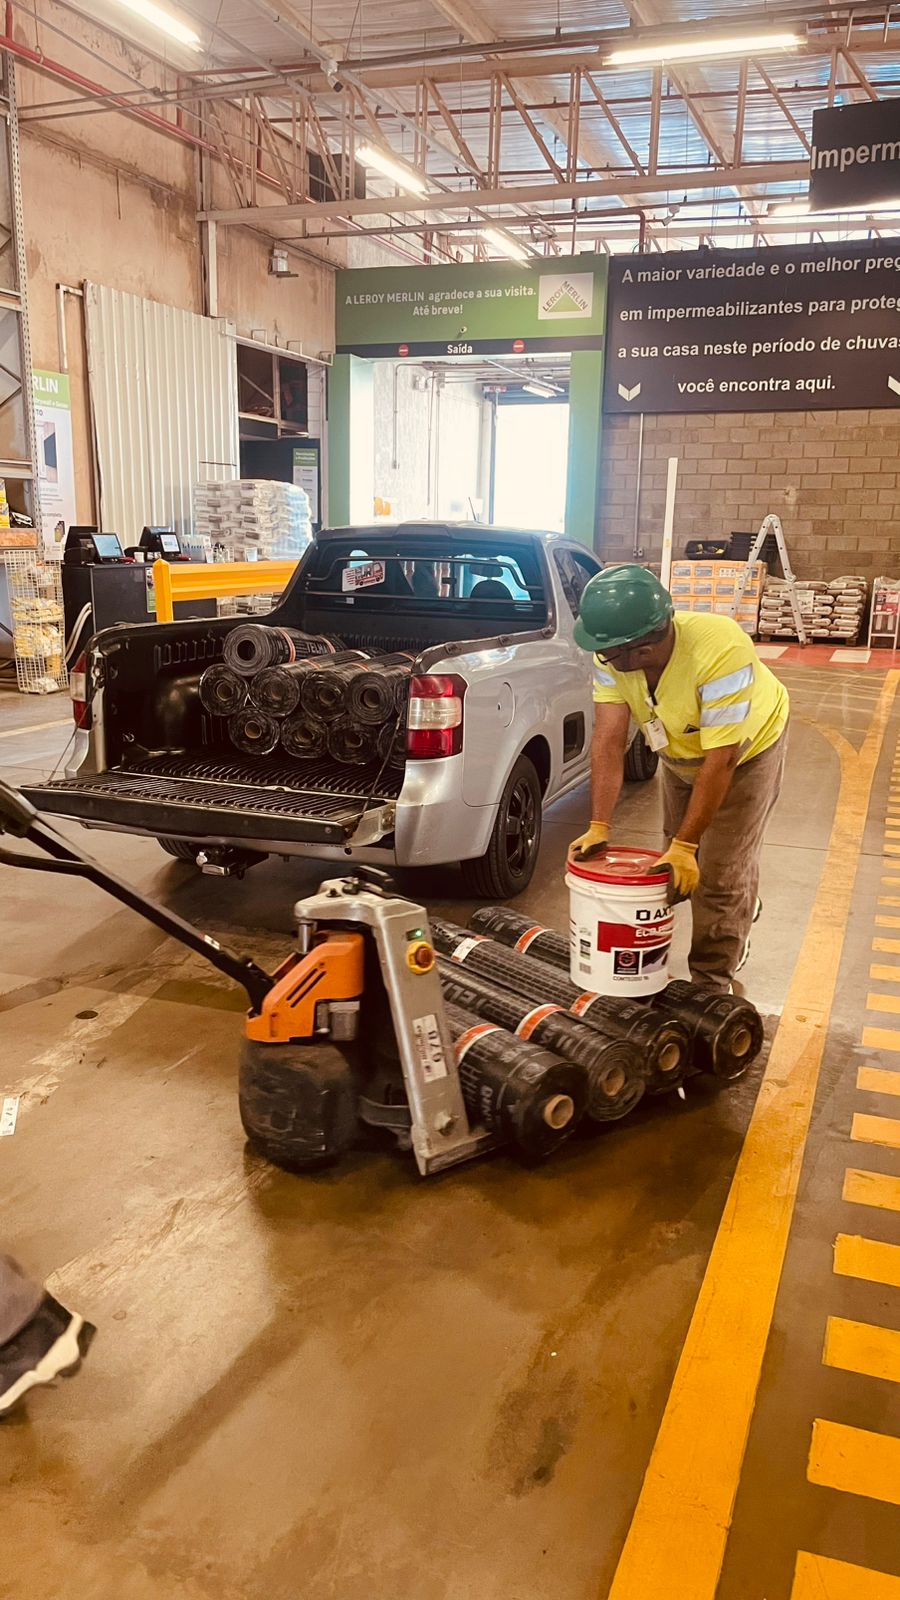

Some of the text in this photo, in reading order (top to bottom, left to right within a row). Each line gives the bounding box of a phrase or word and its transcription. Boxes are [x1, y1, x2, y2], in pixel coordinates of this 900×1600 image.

[811, 140, 900, 171] Imperm
[622, 269, 634, 283] A
[637, 266, 682, 282] maior
[687, 261, 766, 280] variedade
[770, 262, 780, 275] e
[785, 261, 796, 274] o
[800, 256, 861, 273] melhor
[345, 285, 537, 305] A LEROY MERLIN agradece a sua visita.
[542, 280, 589, 312] LEROY MERLIN
[412, 304, 464, 316] Até breve!
[620, 308, 643, 321] em
[647, 300, 804, 322] impermeabilizantes
[808, 298, 845, 316] para
[446, 342, 473, 354] Saída
[618, 334, 900, 358] a sua casa neste período de chuva
[677, 375, 836, 393] você encontra aqui.
